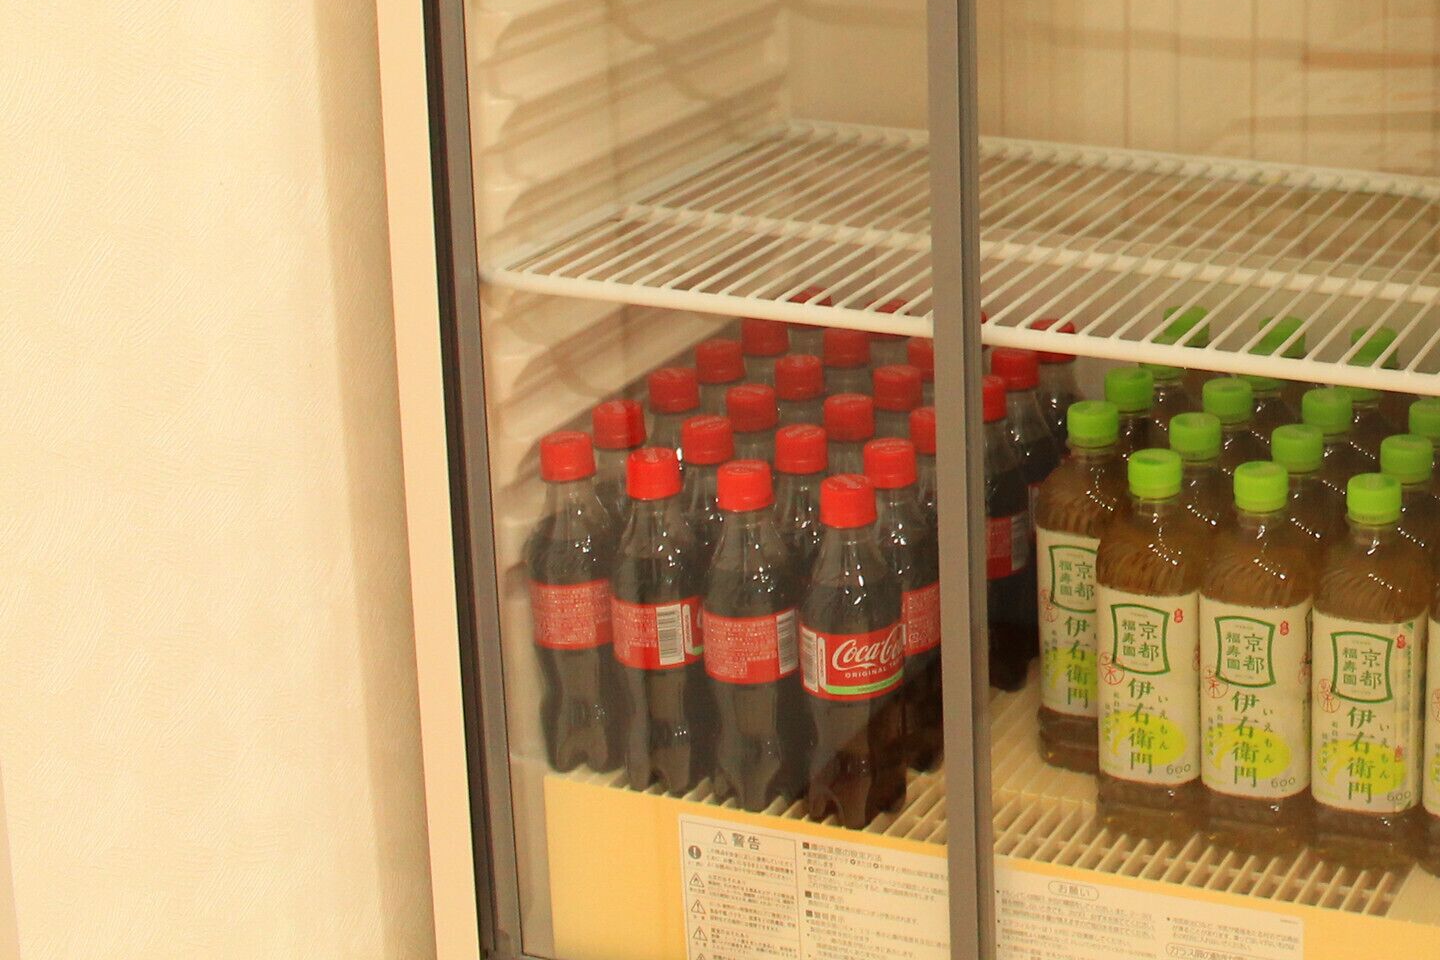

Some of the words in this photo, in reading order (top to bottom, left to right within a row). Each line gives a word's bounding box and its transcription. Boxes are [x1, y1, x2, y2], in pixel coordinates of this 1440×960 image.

[1074, 561, 1096, 601] 京都
[1138, 621, 1159, 662] 京都
[1243, 633, 1265, 675] 京都
[845, 666, 888, 679] ORIGINAL
[1064, 615, 1090, 710] 伊右衛門
[1360, 648, 1382, 690] 京都
[1127, 678, 1155, 775] 伊右衛門
[1231, 690, 1260, 789] 伊右衛門
[1166, 762, 1192, 776] 600
[1347, 706, 1376, 804] 伊右衛門
[1270, 775, 1296, 790] 600
[1386, 791, 1412, 803] 600
[732, 833, 761, 851] 警告
